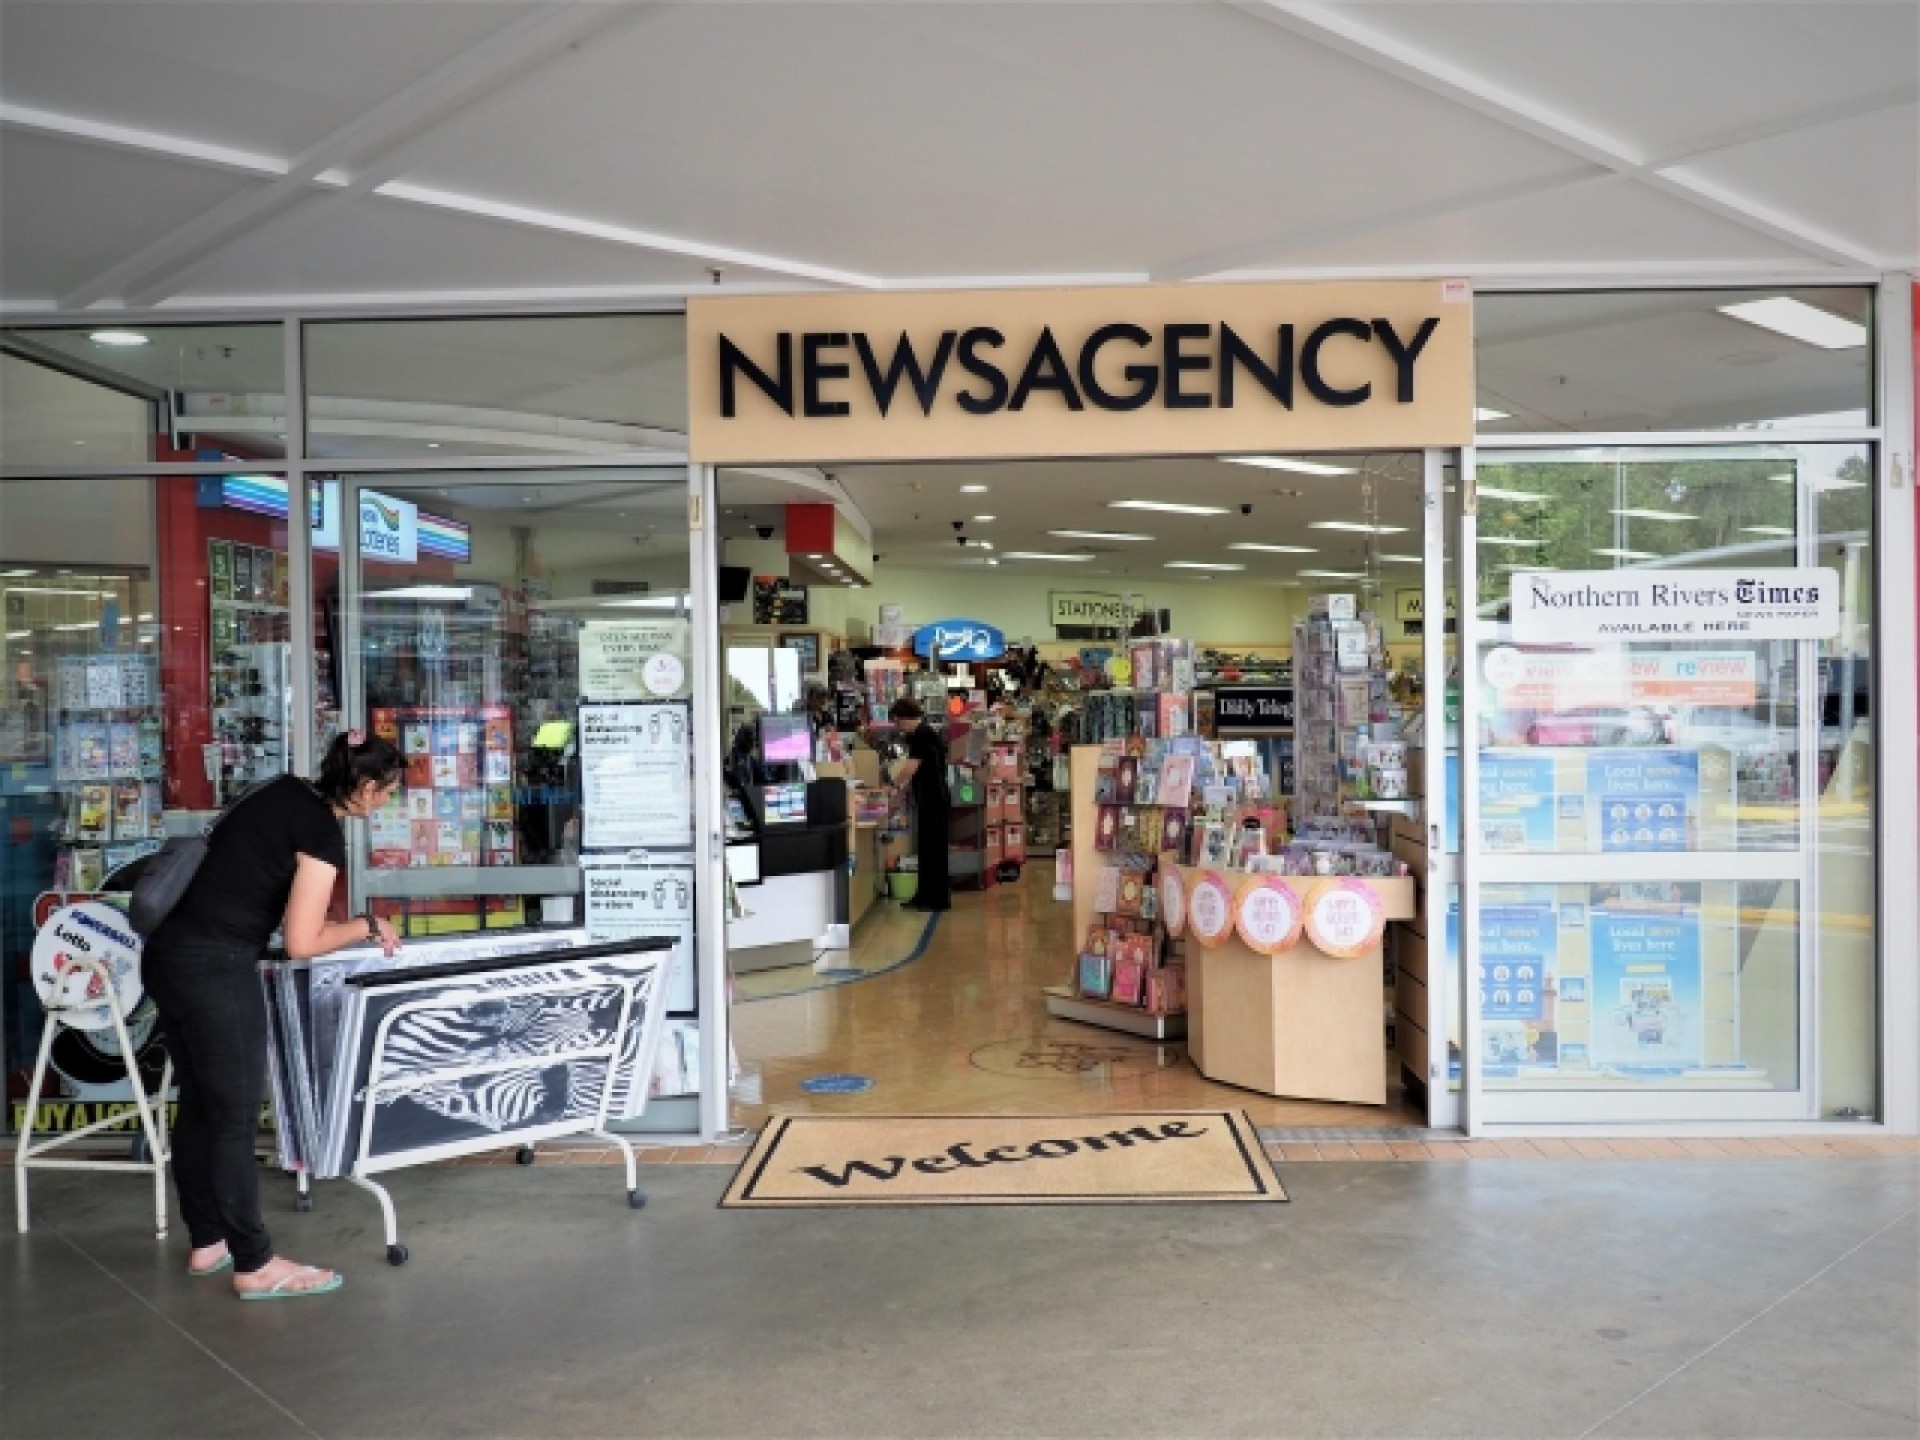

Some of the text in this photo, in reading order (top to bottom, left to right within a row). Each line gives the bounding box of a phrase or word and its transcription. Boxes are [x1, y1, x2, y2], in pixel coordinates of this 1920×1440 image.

[718, 317, 1441, 419] NEWSAGENCY
[1530, 578, 1819, 610] Northern Rivers Times
[1598, 619, 1750, 634] AVAILABLE HERE
[53, 924, 91, 951] Lotto
[790, 1119, 1208, 1188] Welcome
